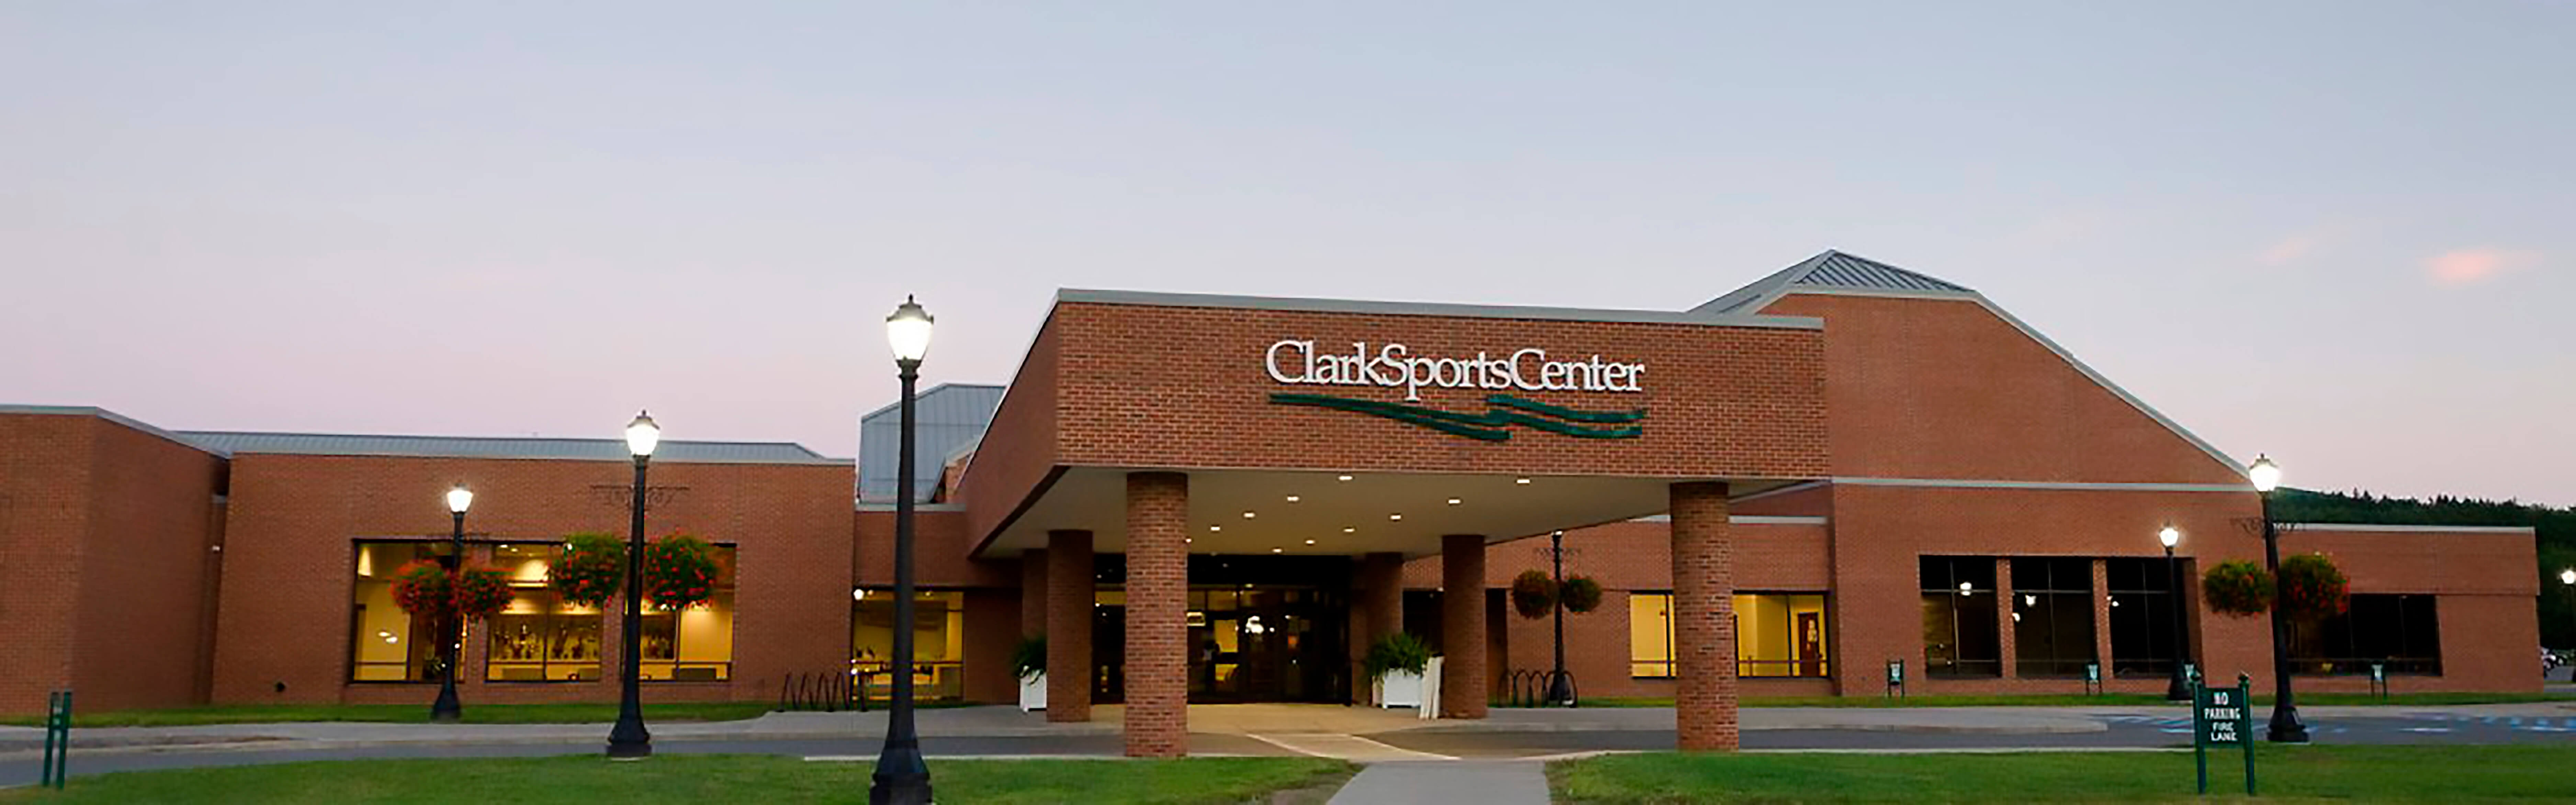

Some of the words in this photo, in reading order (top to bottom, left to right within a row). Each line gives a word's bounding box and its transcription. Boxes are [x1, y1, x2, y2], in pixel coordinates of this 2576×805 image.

[2214, 691, 2229, 705] NO
[2204, 707, 2241, 719] PARKING
[2213, 722, 2234, 732] FIRE
[2211, 732, 2237, 741] LANE
